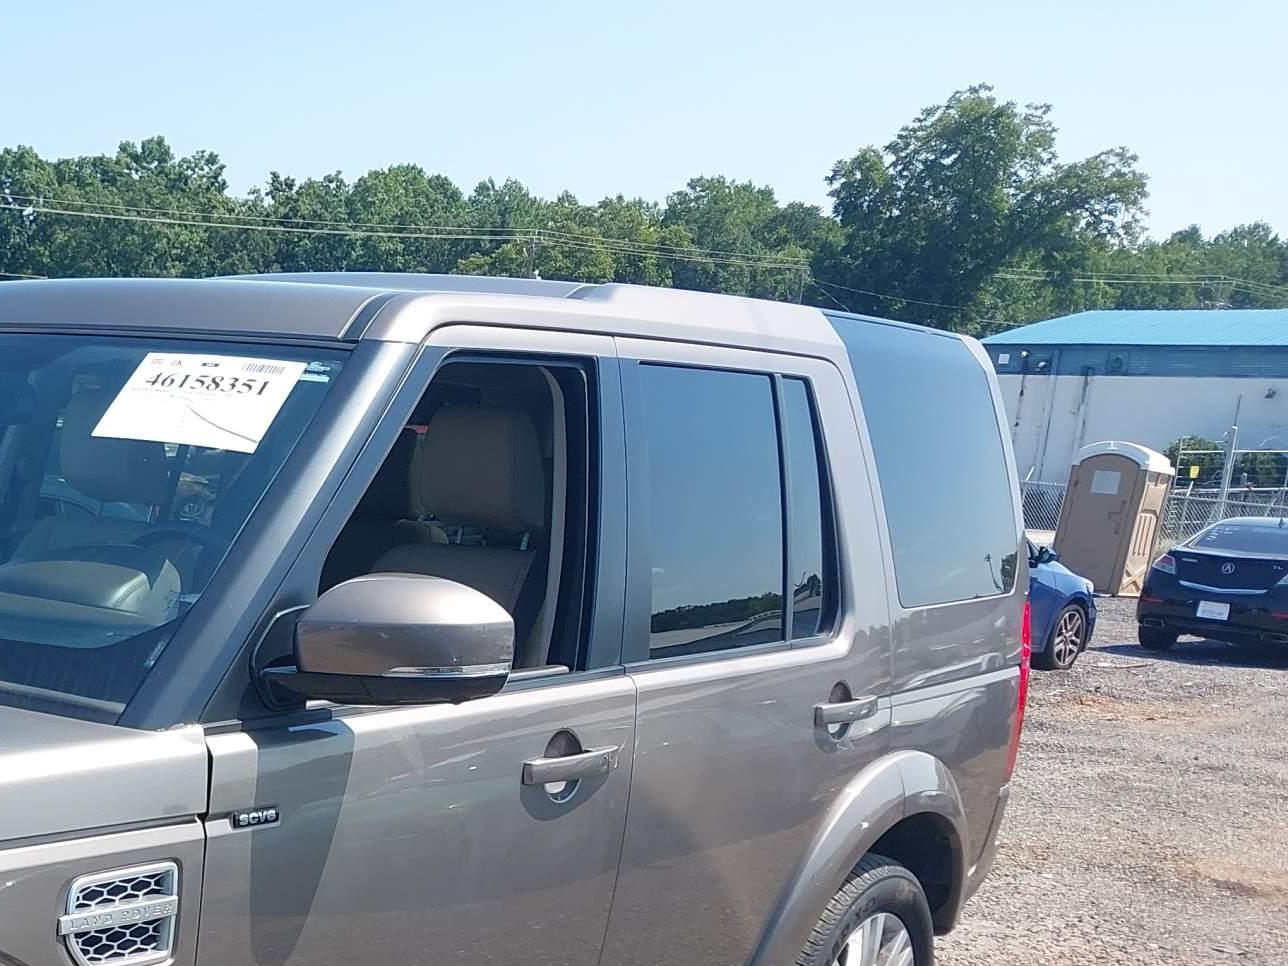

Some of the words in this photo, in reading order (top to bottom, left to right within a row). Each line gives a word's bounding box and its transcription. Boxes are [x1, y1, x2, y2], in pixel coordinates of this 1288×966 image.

[145, 371, 270, 396] 46158351
[239, 809, 277, 826] SCV6
[69, 913, 113, 931] LAND
[120, 903, 173, 922] ROVER
